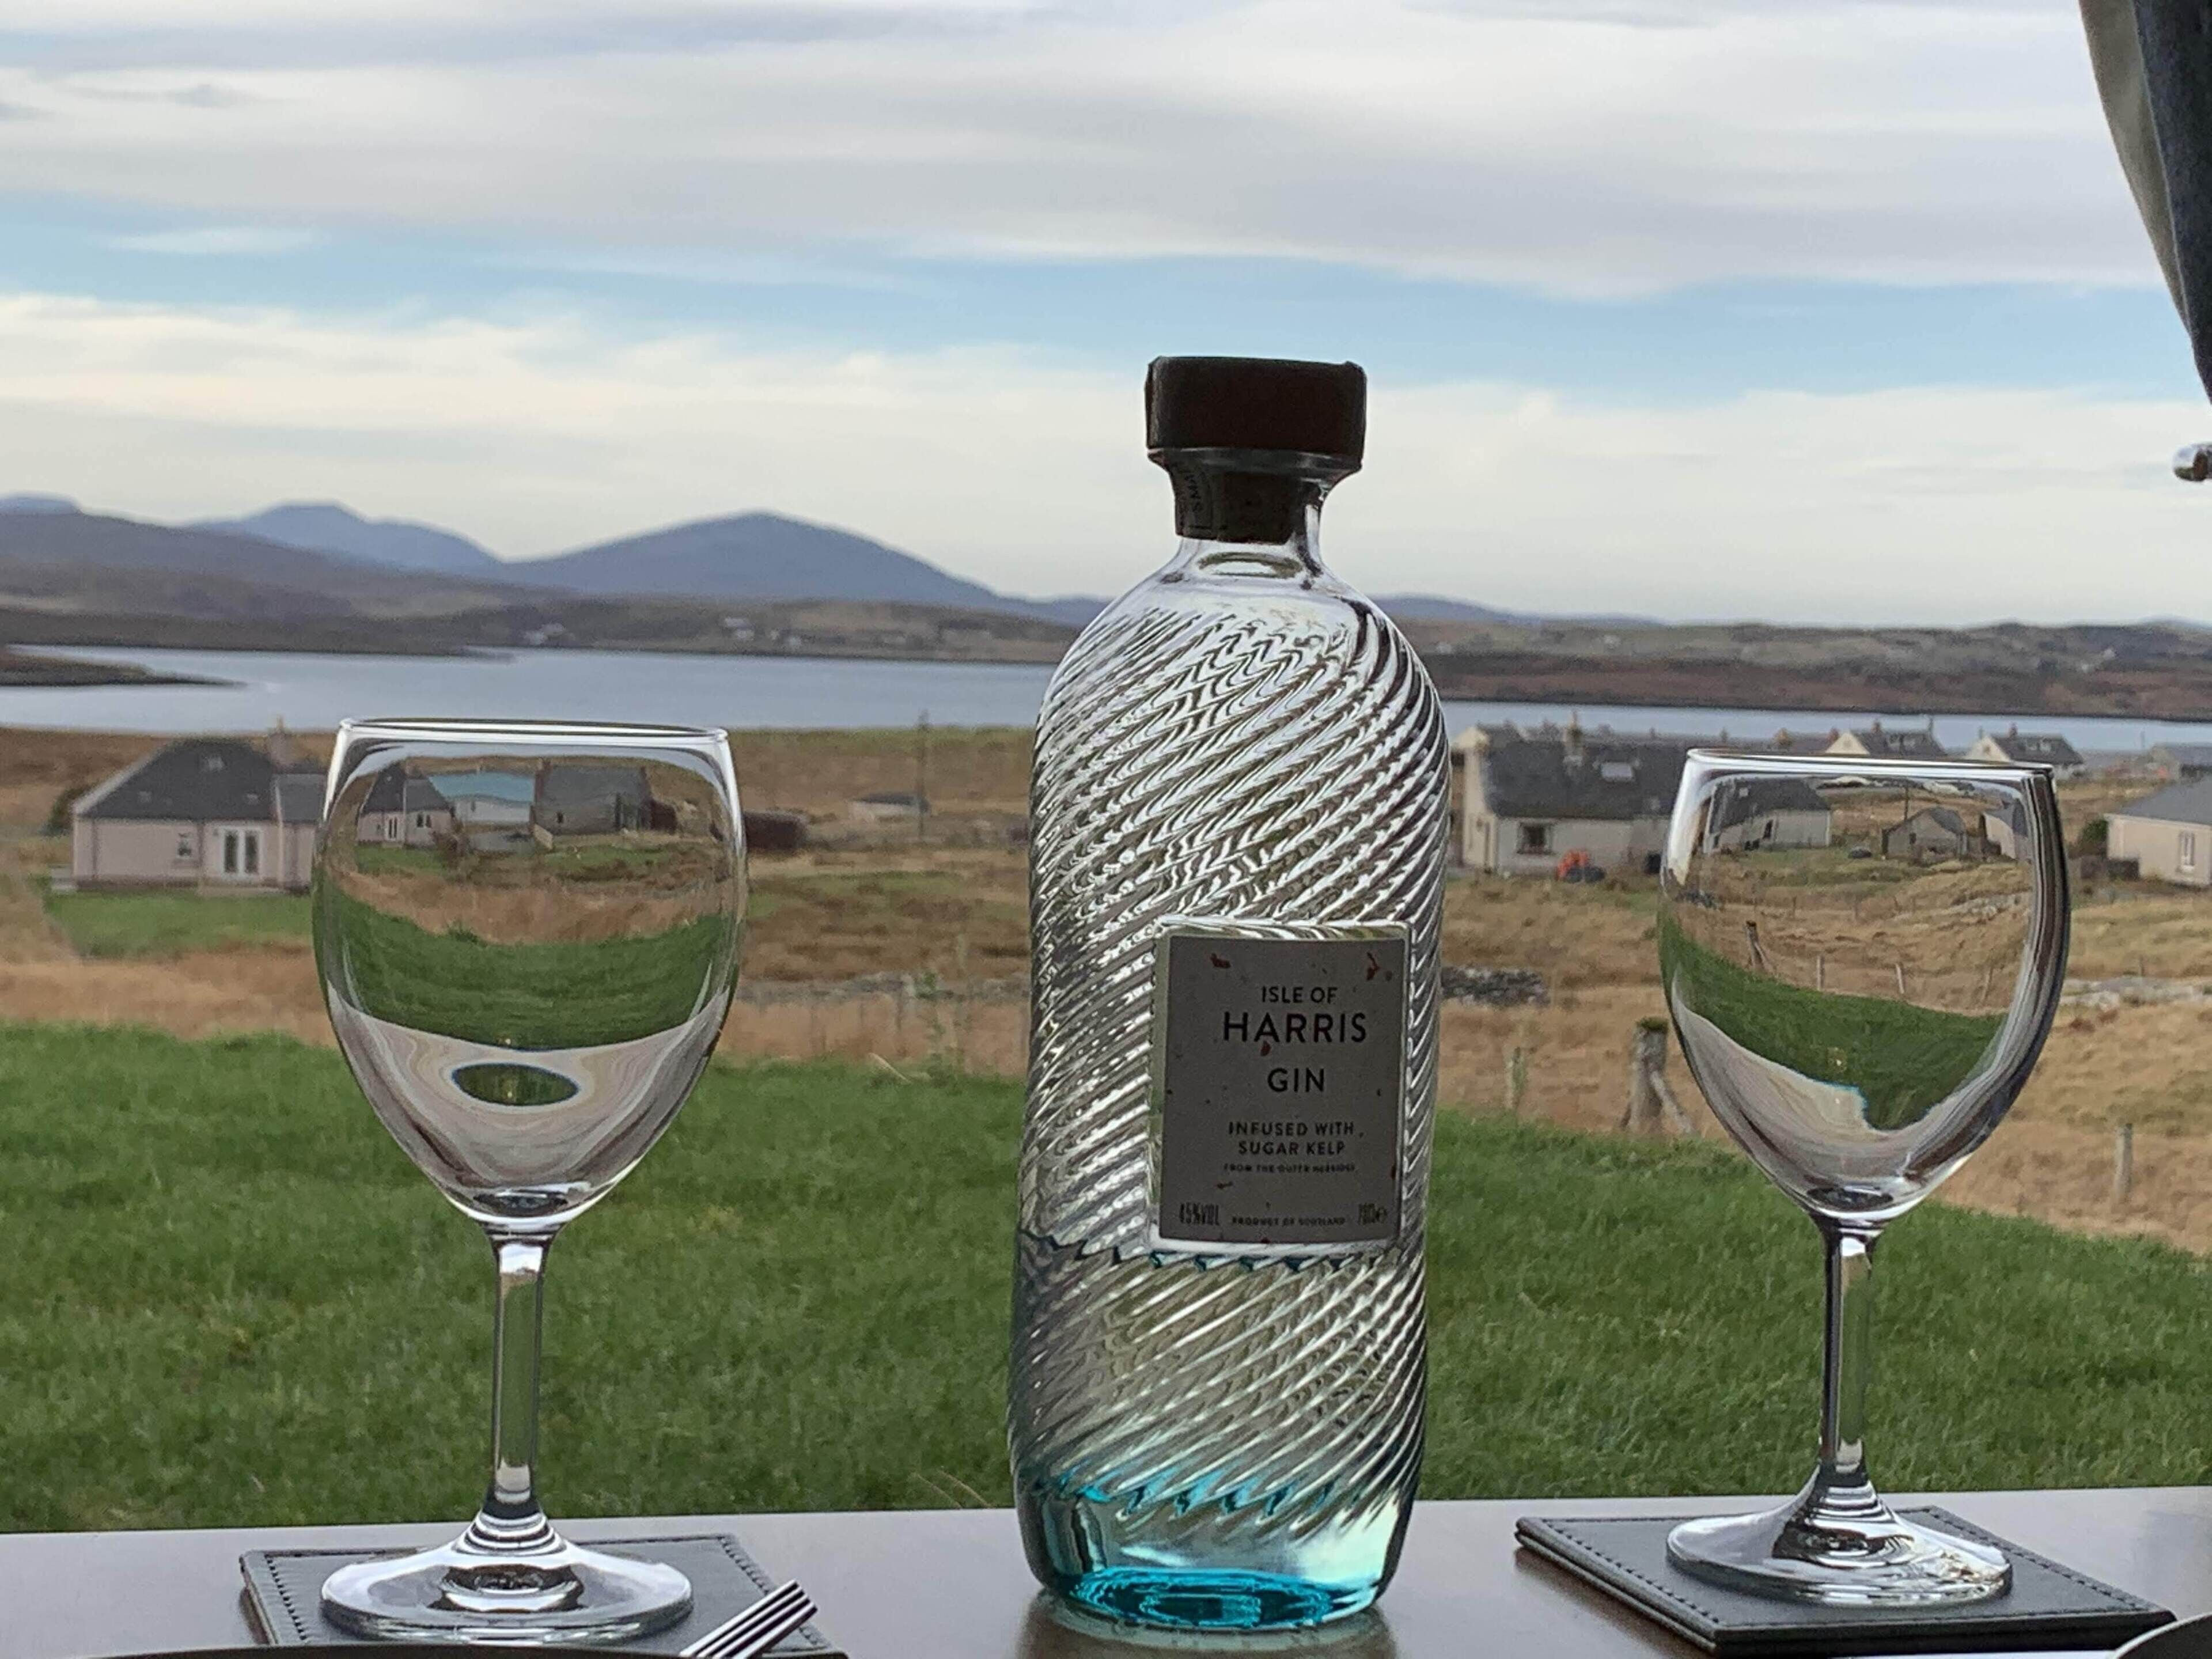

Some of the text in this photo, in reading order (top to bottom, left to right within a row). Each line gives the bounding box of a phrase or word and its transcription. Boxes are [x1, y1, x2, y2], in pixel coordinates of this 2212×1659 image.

[1262, 986, 1338, 1004] ISLE OF
[1223, 1011, 1367, 1043] HARRIS
[1267, 1067, 1324, 1093] GIN
[1228, 1121, 1354, 1137] INFUSED WITH
[1238, 1140, 1346, 1156] SUGAR KELP
[1256, 1164, 1274, 1173] THE
